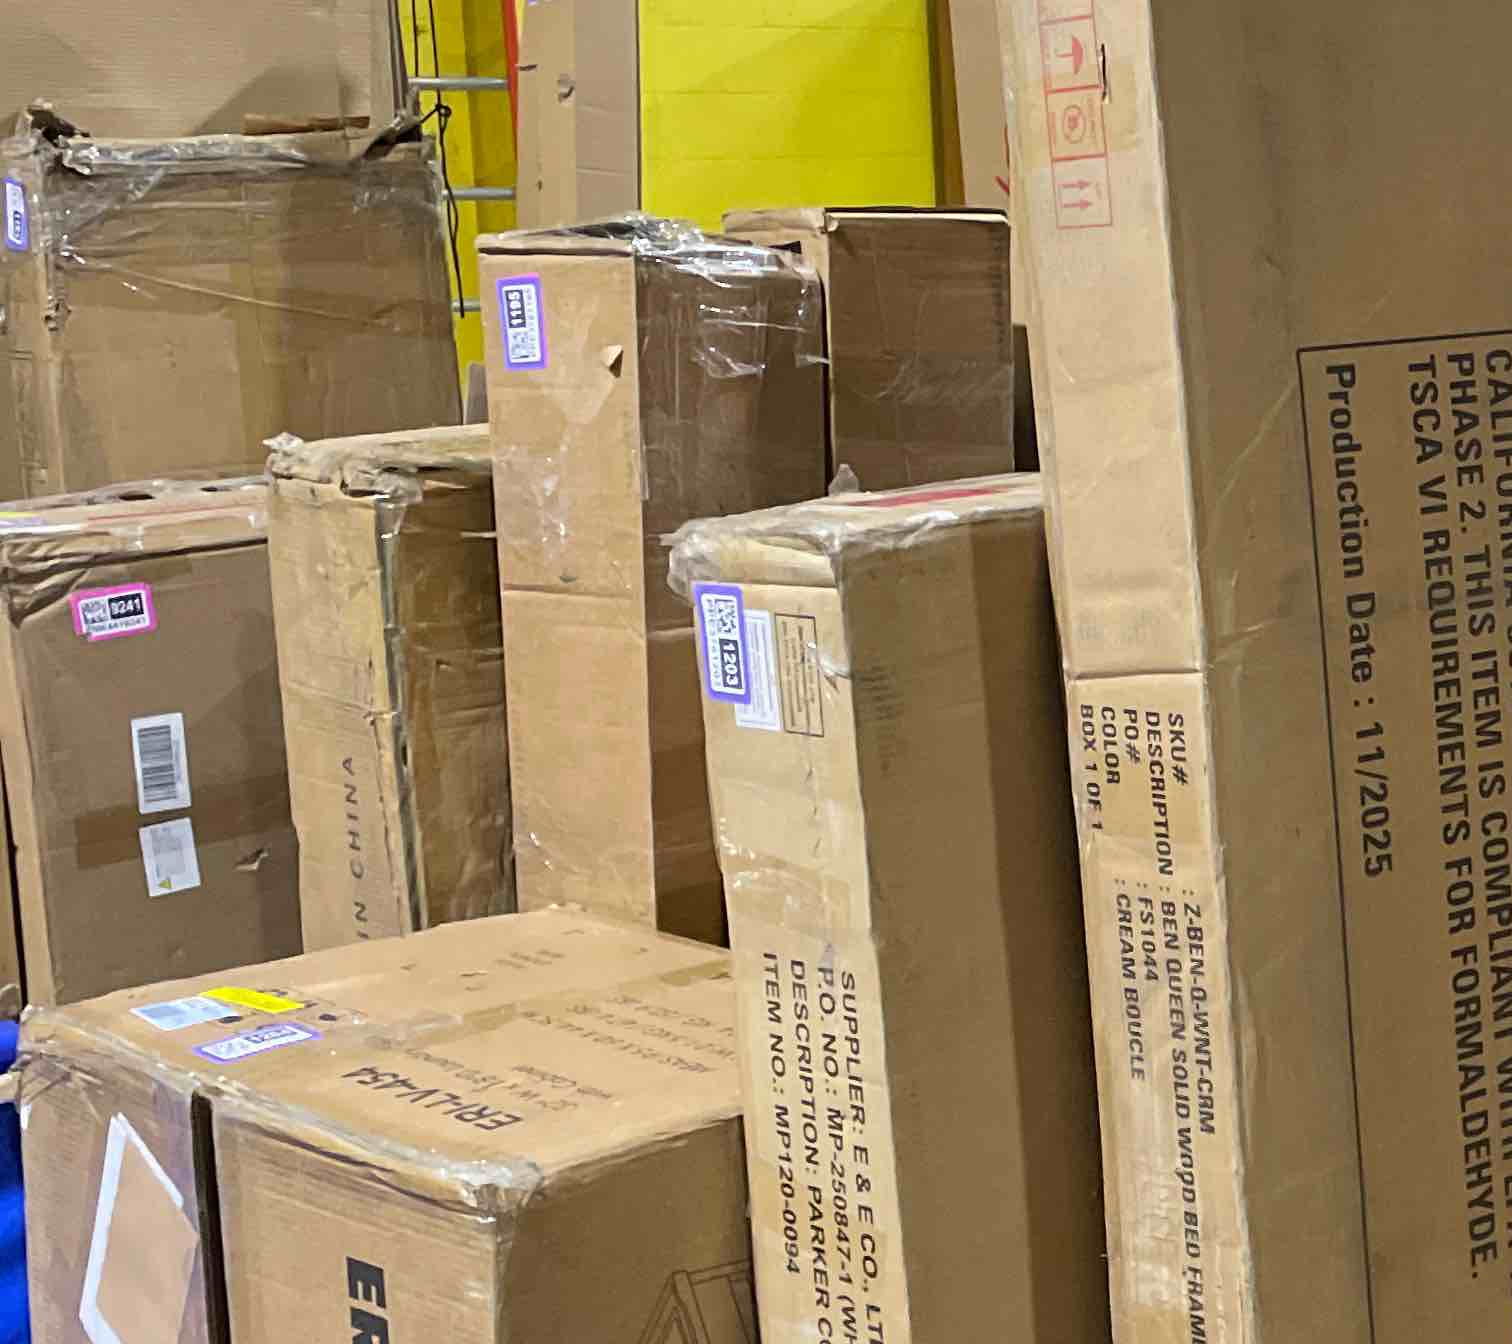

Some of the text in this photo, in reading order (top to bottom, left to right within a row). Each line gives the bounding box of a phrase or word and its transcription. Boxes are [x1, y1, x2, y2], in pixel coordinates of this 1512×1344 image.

[1447, 352, 1484, 488] PHASE
[1326, 363, 1368, 579] Production
[1458, 500, 1485, 534] 2.
[1463, 544, 1496, 635] THIS
[723, 643, 739, 686] 1203
[1346, 591, 1378, 684] Date
[1080, 703, 1097, 751] BOX
[1469, 651, 1502, 749] ITEM
[1101, 706, 1121, 786] COLOR
[1168, 712, 1189, 786] SKU#
[1476, 761, 1505, 800] IS
[1088, 781, 1102, 812] OF
[1145, 711, 1173, 876] DESCRIPTION
[1355, 720, 1393, 878] 11/2025
[1407, 355, 1498, 1280] TSCA VI REQUIREMENTS FOR FORMALDEHYDE.
[342, 756, 369, 941] IN CHINA
[1123, 708, 1141, 765] PO#
[1138, 896, 1160, 983] FS1044
[1116, 893, 1137, 982] CREAM
[1161, 902, 1180, 951] BEN
[817, 967, 836, 1022] P.O.
[1124, 986, 1145, 1082] BOUCLE
[1166, 958, 1187, 1040] QUEEN
[822, 1034, 840, 1095] NO.:
[841, 972, 866, 1134] SUPPLIER:
[1172, 1047, 1191, 1120] SOLID
[763, 953, 799, 1273] ITEM NO.: MP120-0094
[790, 960, 819, 1174] DESCRIPTION:
[807, 1184, 830, 1308] PARKER
[827, 1107, 853, 1284] MP-250847-1
[853, 1145, 869, 1165] E
[855, 1174, 872, 1193] &
[1175, 1126, 1196, 1204] WOOD
[858, 1206, 874, 1225] E
[1184, 1209, 1200, 1258] BED
